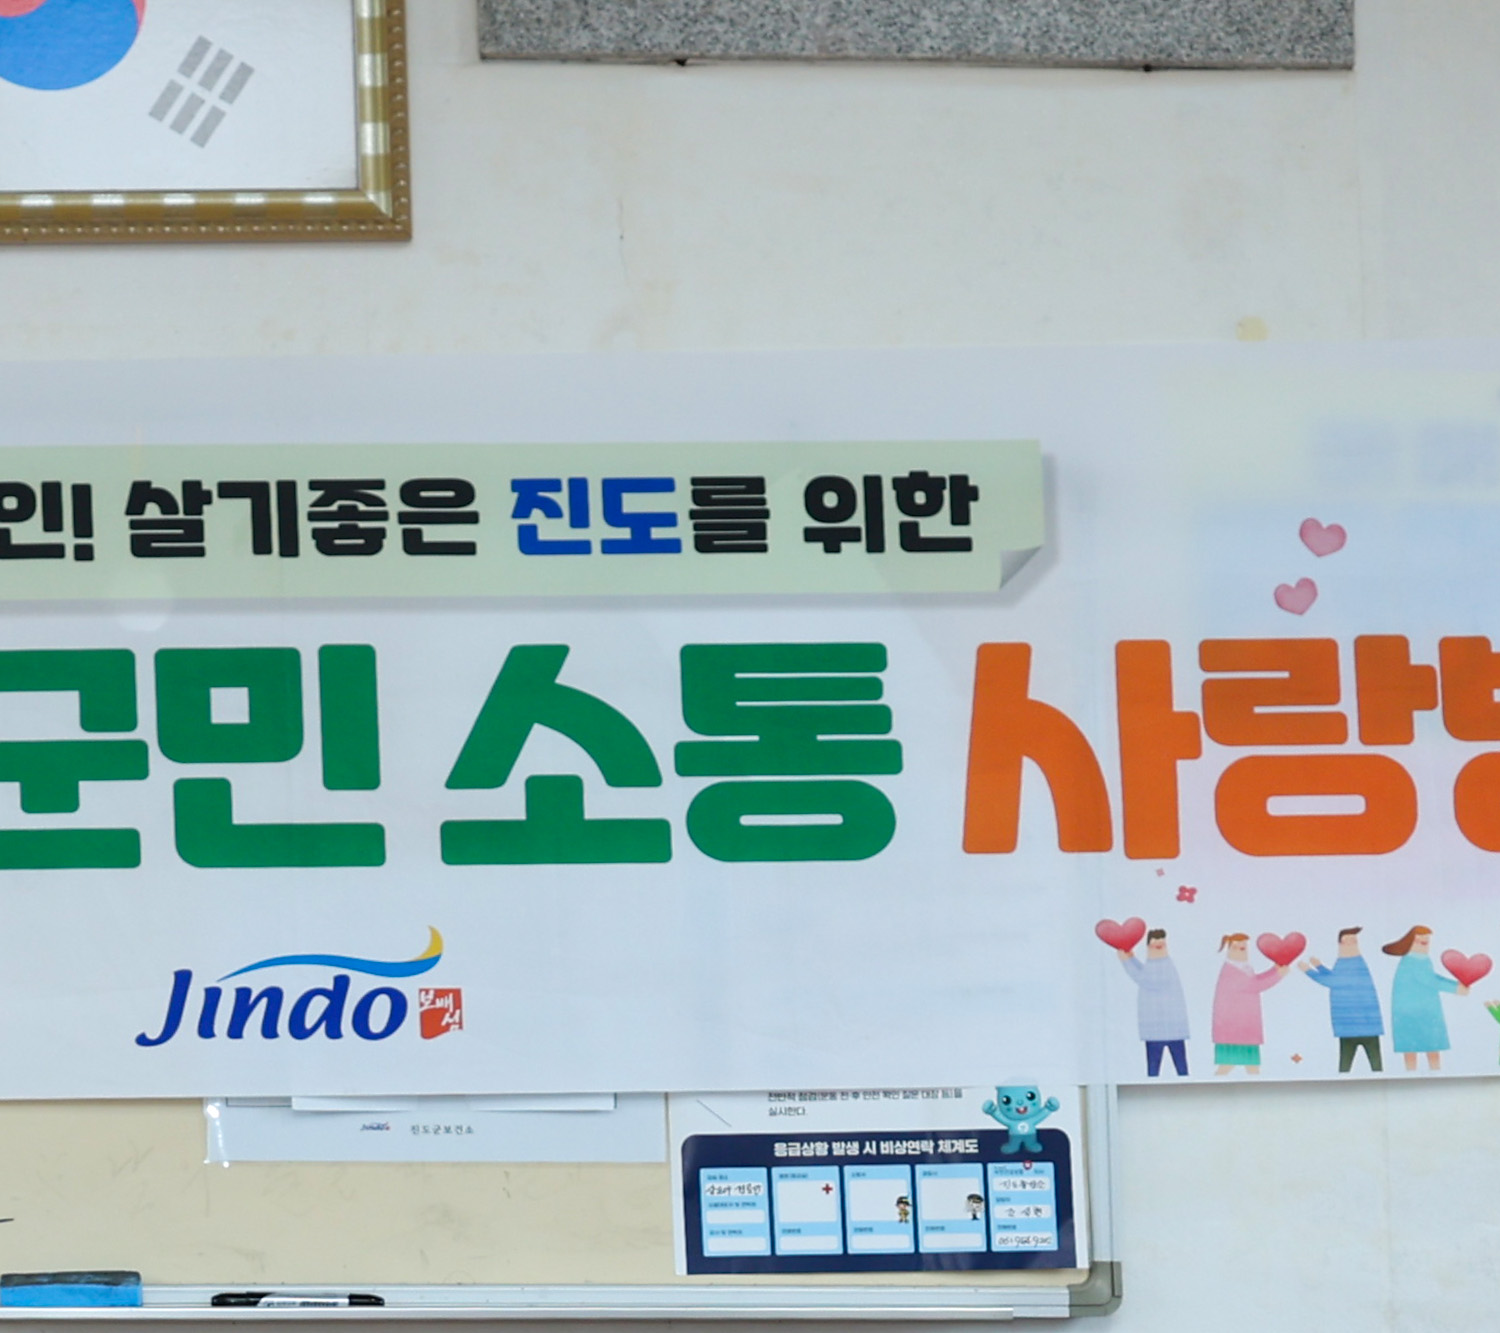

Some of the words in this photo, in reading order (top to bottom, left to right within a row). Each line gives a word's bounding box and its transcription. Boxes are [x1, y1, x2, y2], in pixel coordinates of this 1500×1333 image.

[125, 477, 480, 559] 살기좋은
[510, 474, 771, 556] 진도를
[803, 470, 980, 554] 위한
[439, 642, 904, 866] 소통
[134, 968, 410, 1048] Jindo
[773, 1142, 829, 1157] 응급상황
[831, 1141, 859, 1156] 발생
[863, 1141, 876, 1155] 시
[879, 1140, 934, 1155] 비상연락
[937, 1138, 979, 1154] 체계도
